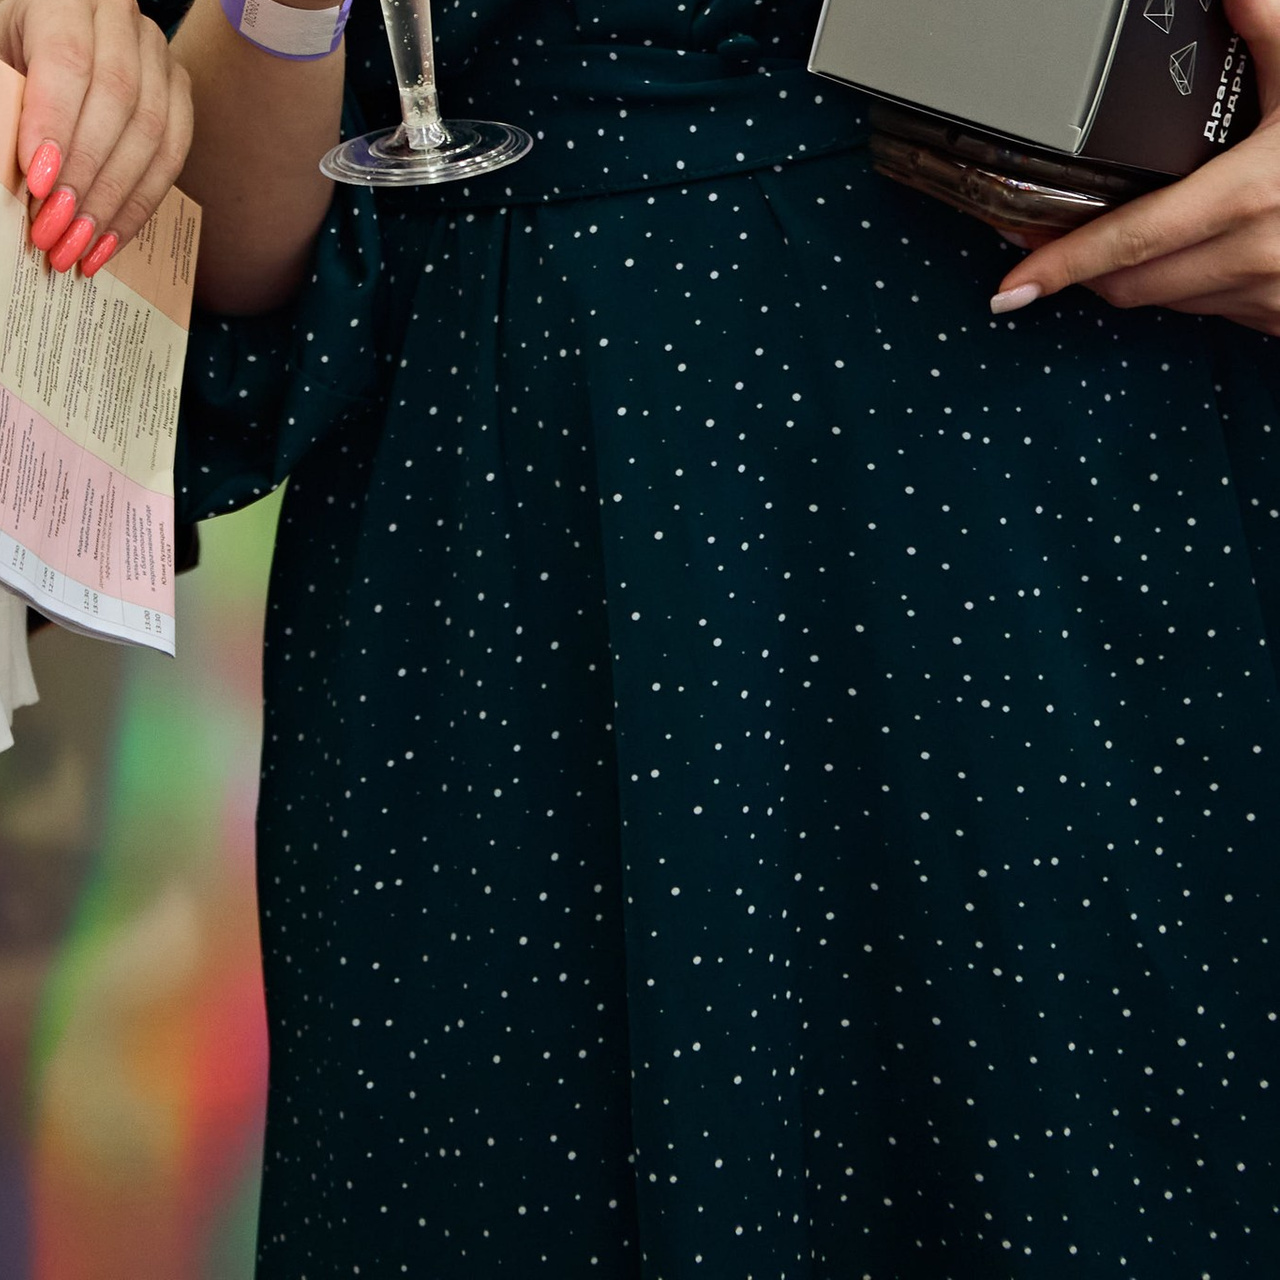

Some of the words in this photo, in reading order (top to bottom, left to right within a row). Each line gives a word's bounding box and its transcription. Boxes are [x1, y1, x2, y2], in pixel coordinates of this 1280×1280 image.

[1218, 56, 1243, 143] кадры
[168, 387, 178, 425] Messenger
[143, 610, 152, 630] 13:00
[154, 613, 162, 633] 13:30
